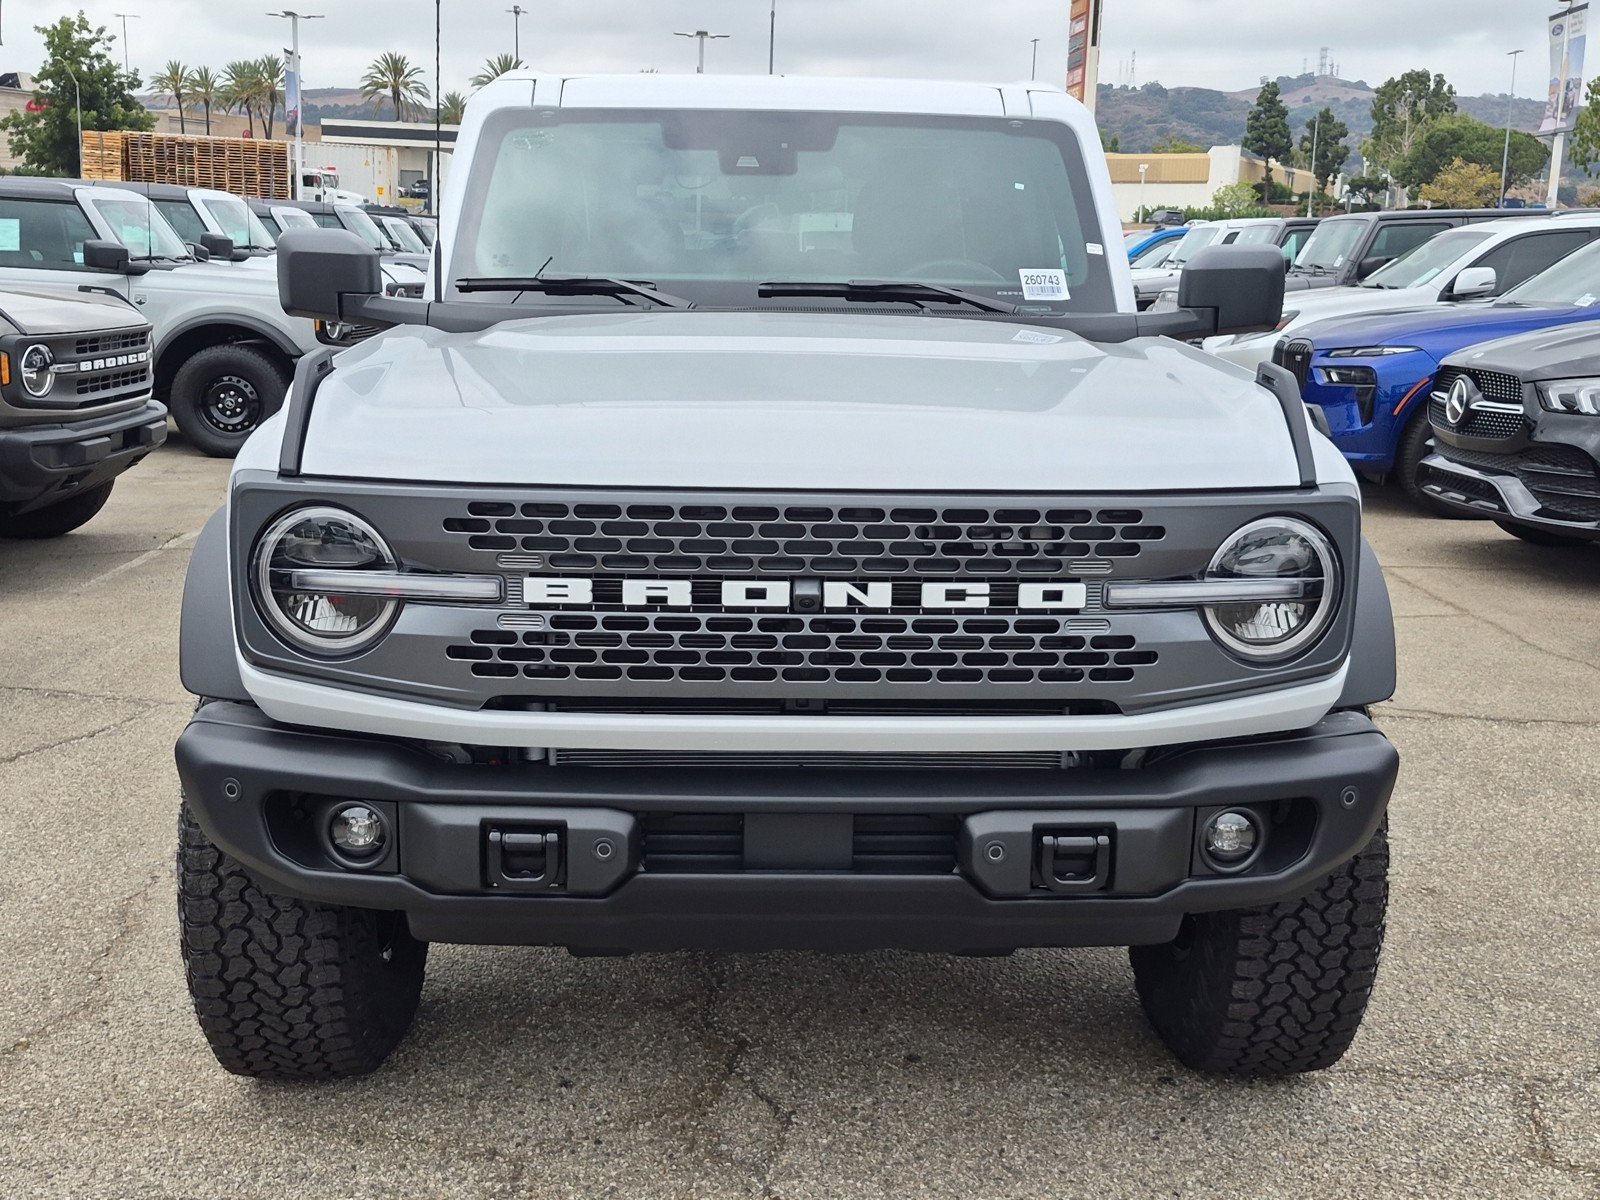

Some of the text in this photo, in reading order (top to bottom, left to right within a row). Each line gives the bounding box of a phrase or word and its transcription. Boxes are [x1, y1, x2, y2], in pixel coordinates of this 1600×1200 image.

[1023, 274, 1061, 286] 260743
[79, 352, 147, 372] BRONCO
[522, 577, 1087, 610] BRONCO
